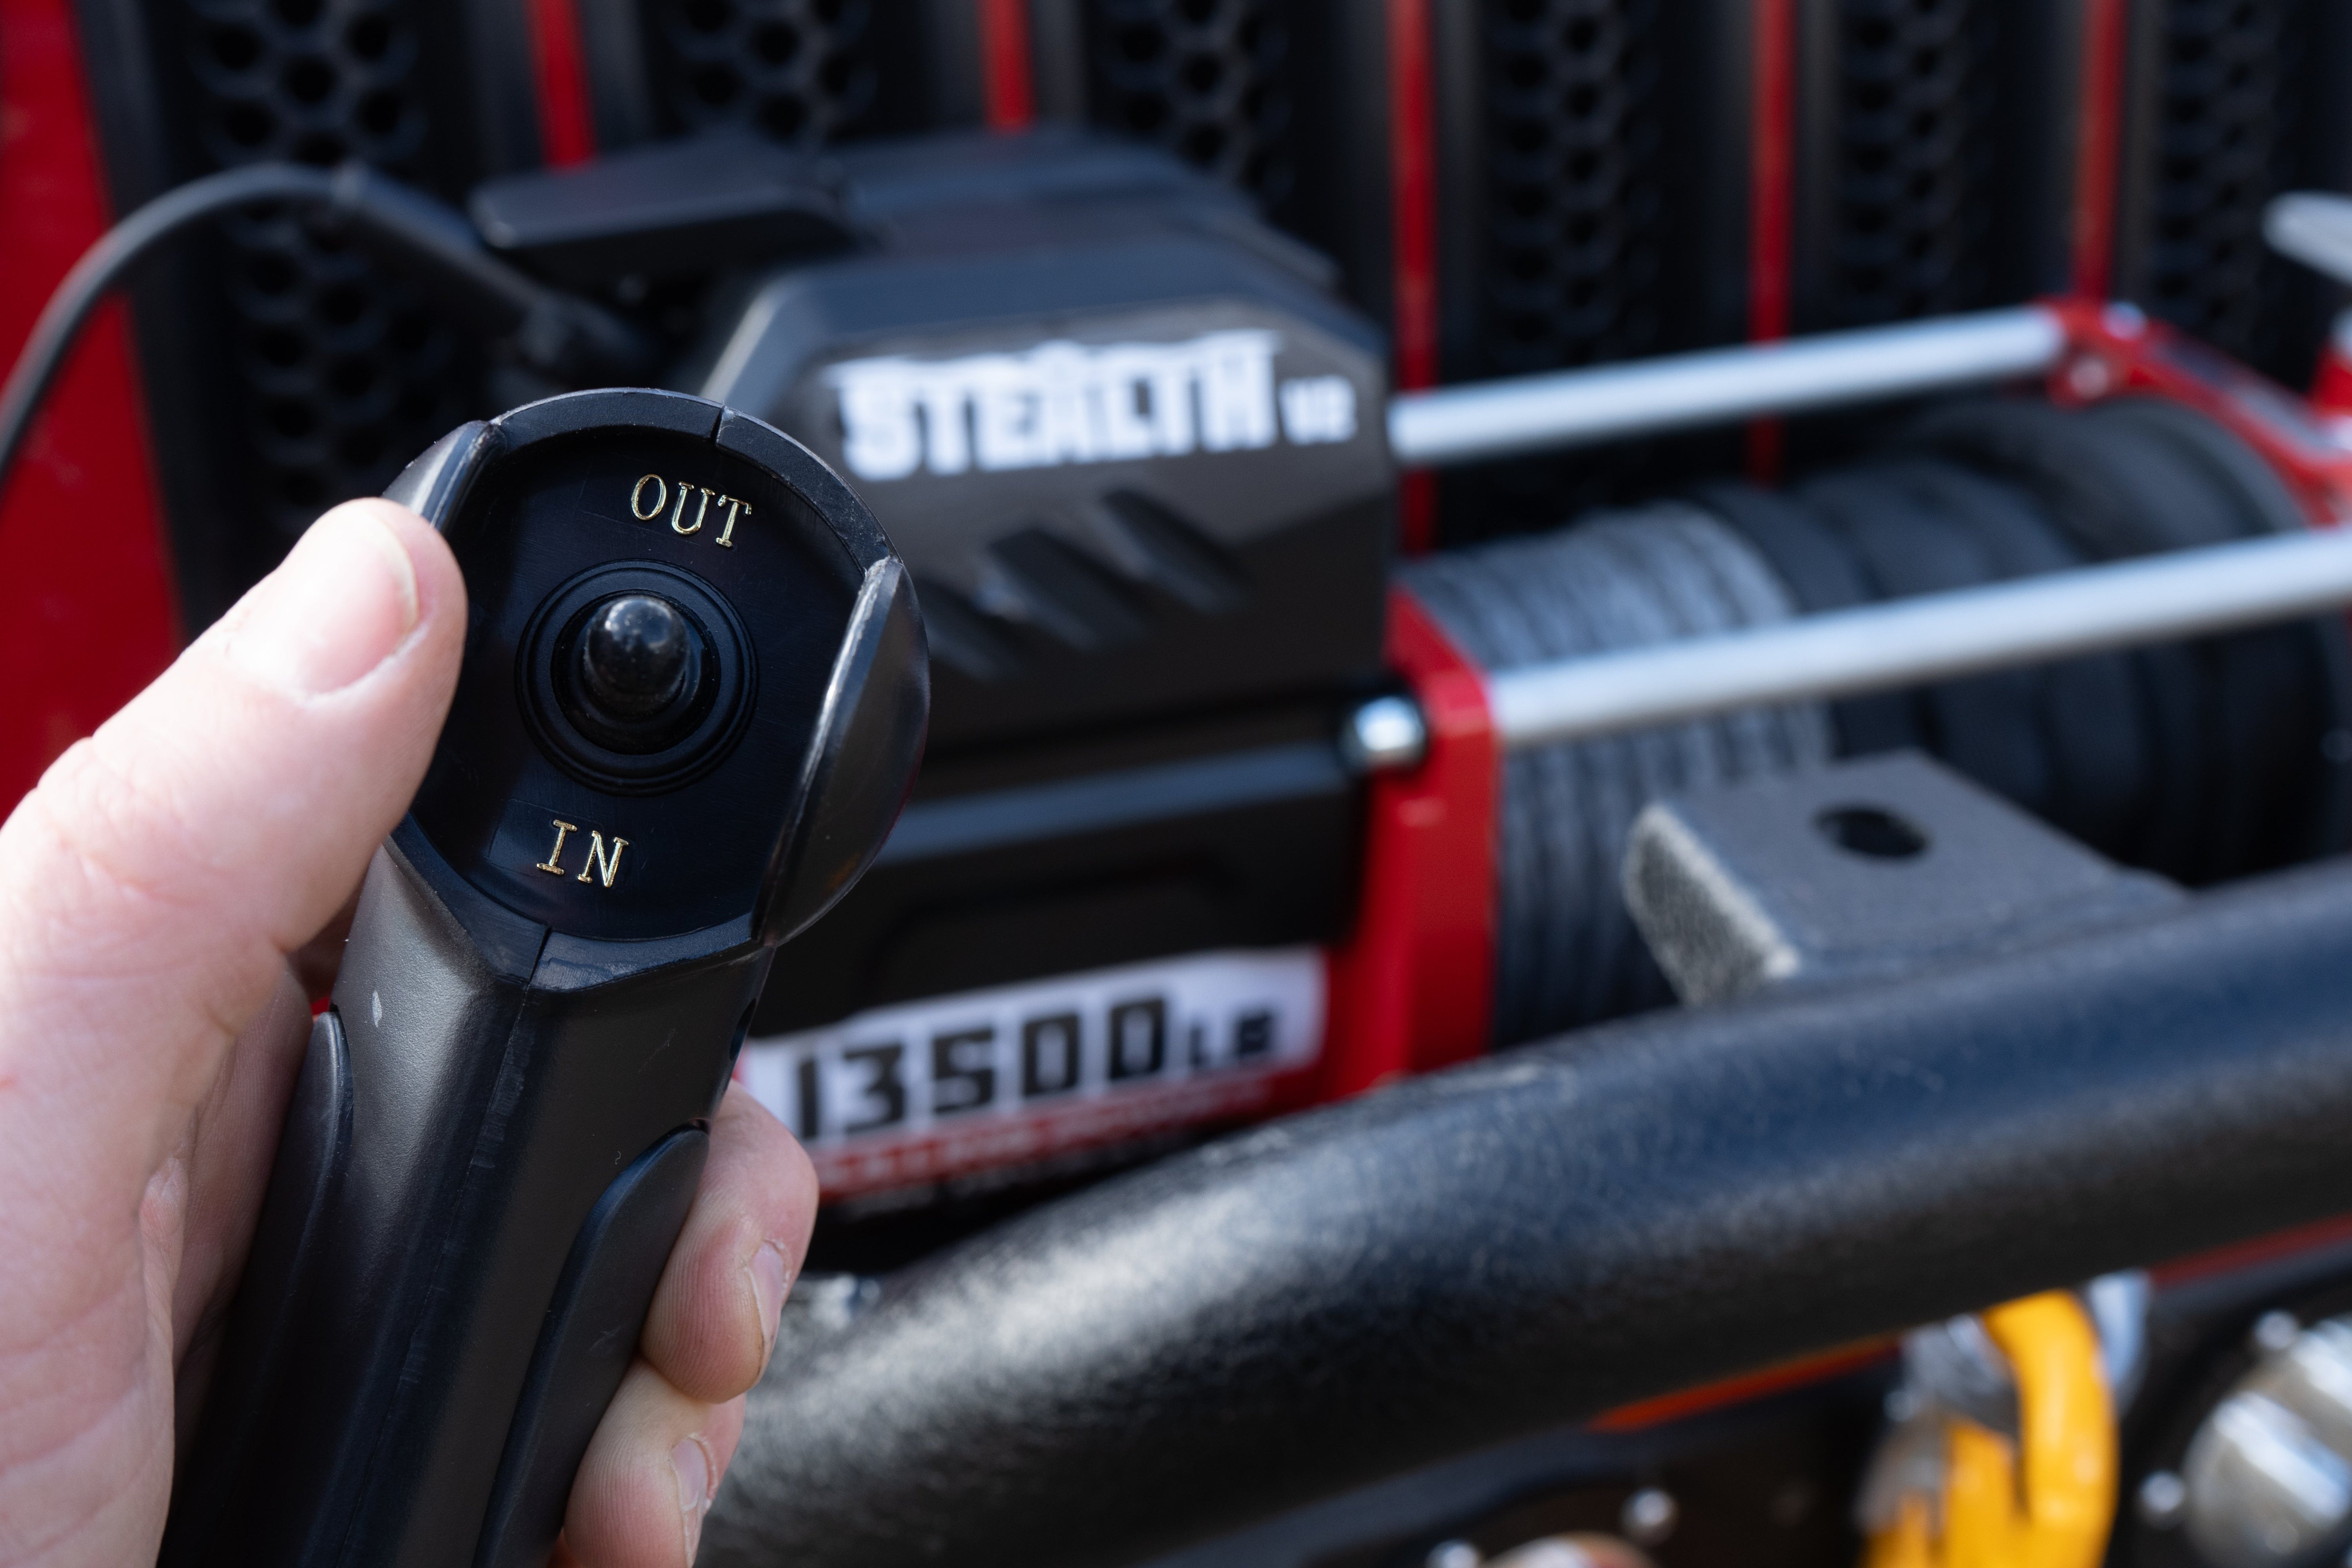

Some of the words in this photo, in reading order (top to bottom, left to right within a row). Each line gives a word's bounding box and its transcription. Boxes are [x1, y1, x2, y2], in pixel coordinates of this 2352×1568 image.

[835, 330, 1278, 480] STEALTH
[631, 474, 752, 548] OUT
[537, 819, 629, 888] IN
[797, 996, 1168, 1141] 13500
